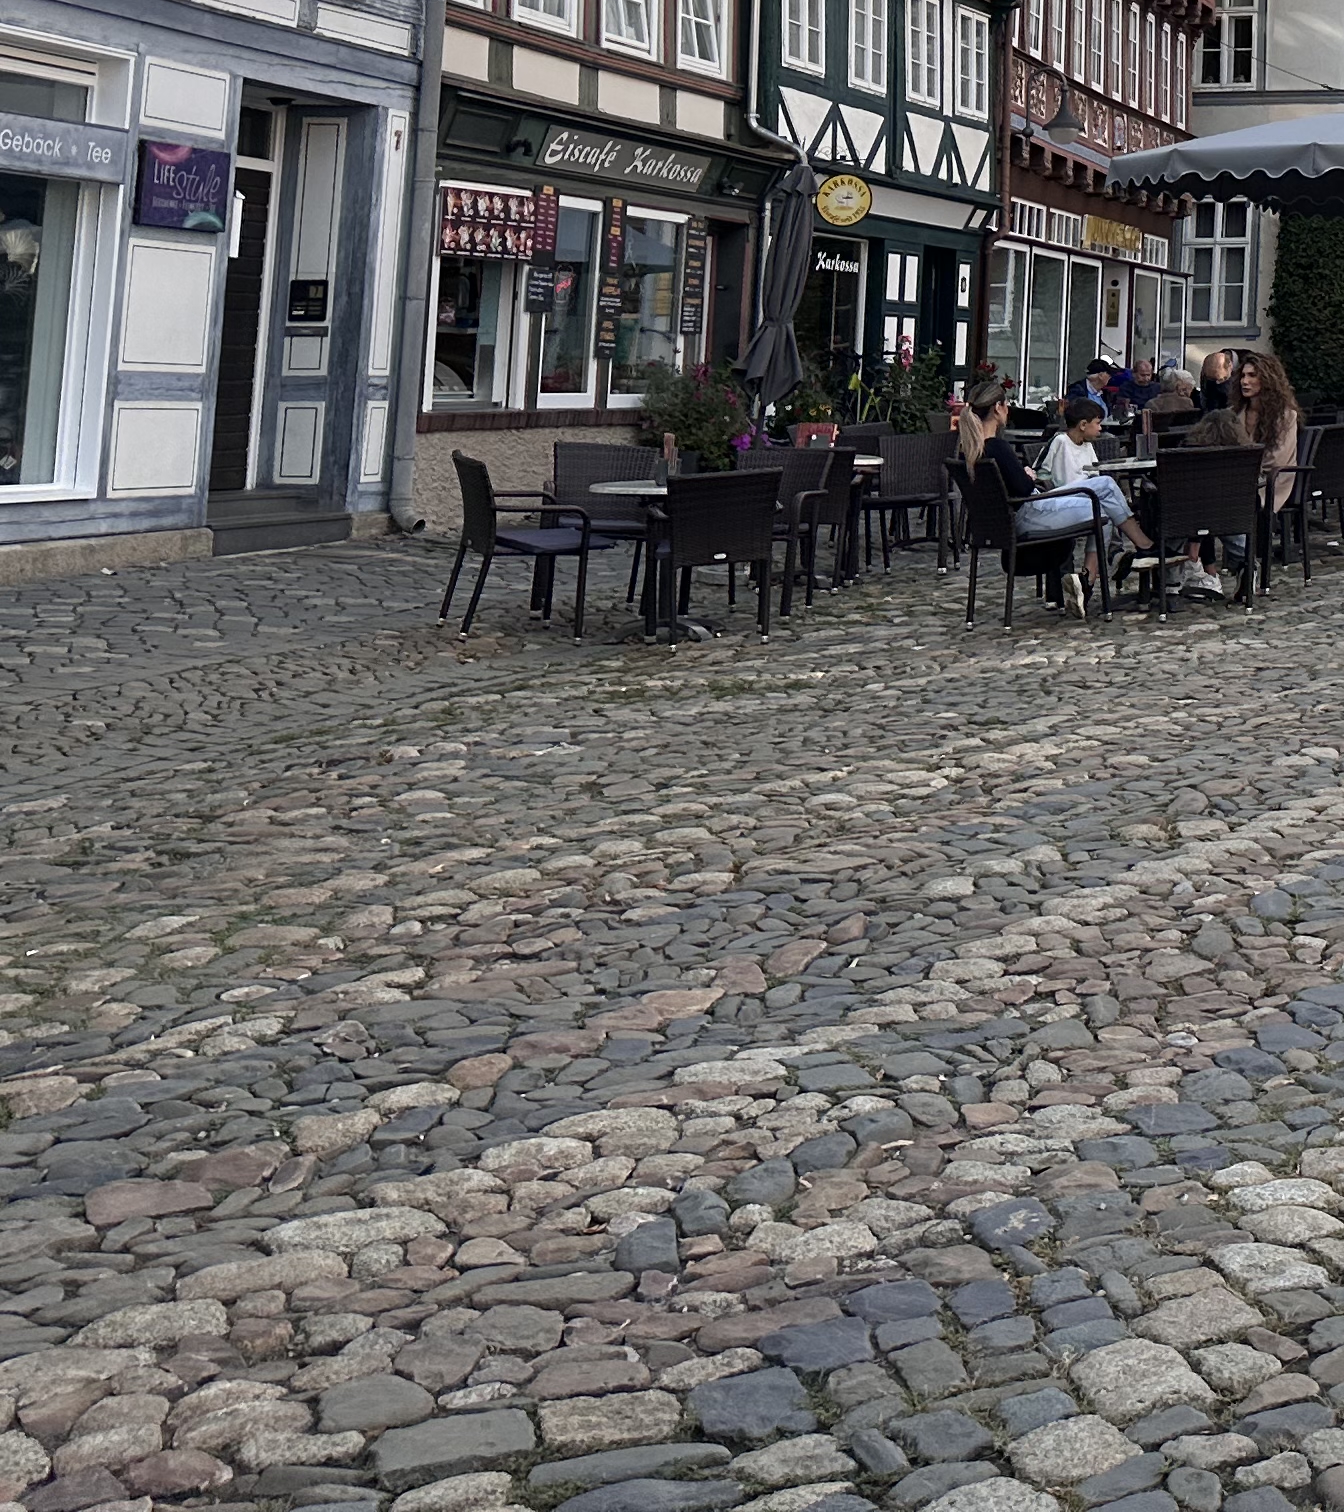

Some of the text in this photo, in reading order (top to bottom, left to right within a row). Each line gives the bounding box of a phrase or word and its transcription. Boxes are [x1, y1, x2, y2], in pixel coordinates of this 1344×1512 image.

[0, 129, 111, 163] Gebäck Tee
[545, 131, 702, 183] Eiscafé Karkossa
[154, 159, 175, 186] LIFE
[815, 251, 860, 273] Karkossa
